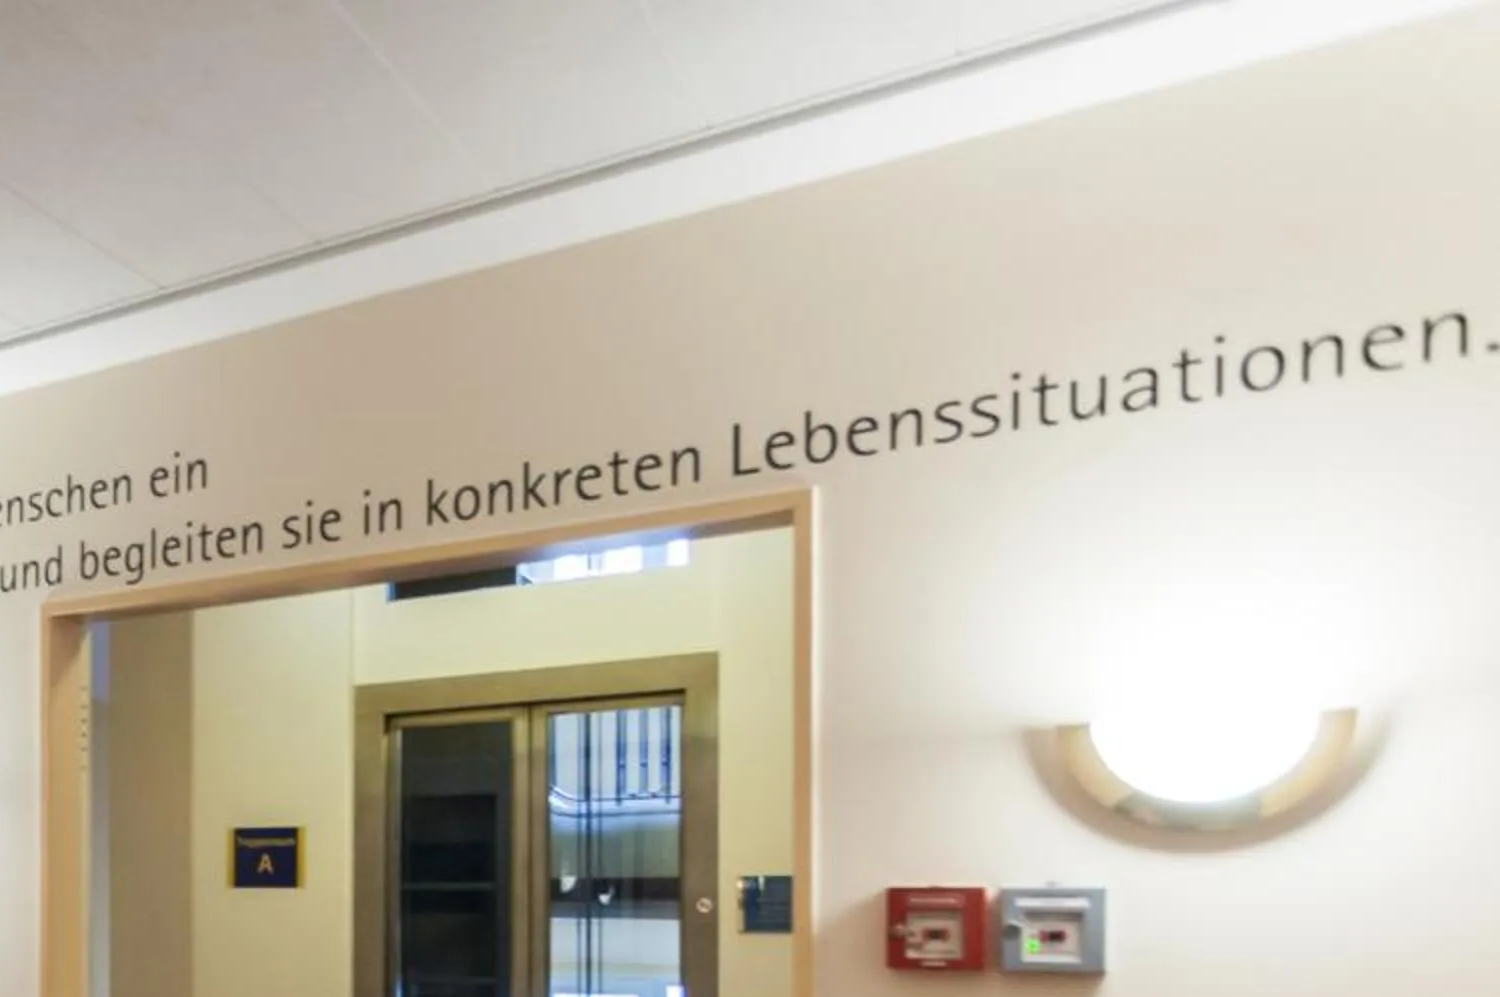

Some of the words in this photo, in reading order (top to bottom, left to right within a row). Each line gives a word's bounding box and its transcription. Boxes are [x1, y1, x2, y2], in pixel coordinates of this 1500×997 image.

[79, 522, 265, 585] begleiten
[281, 500, 343, 550] sie
[361, 489, 404, 536] in
[425, 445, 702, 527] konkreten
[730, 308, 1500, 477] Lebenssituationen.
[148, 450, 209, 498] ein
[257, 853, 274, 875] A
